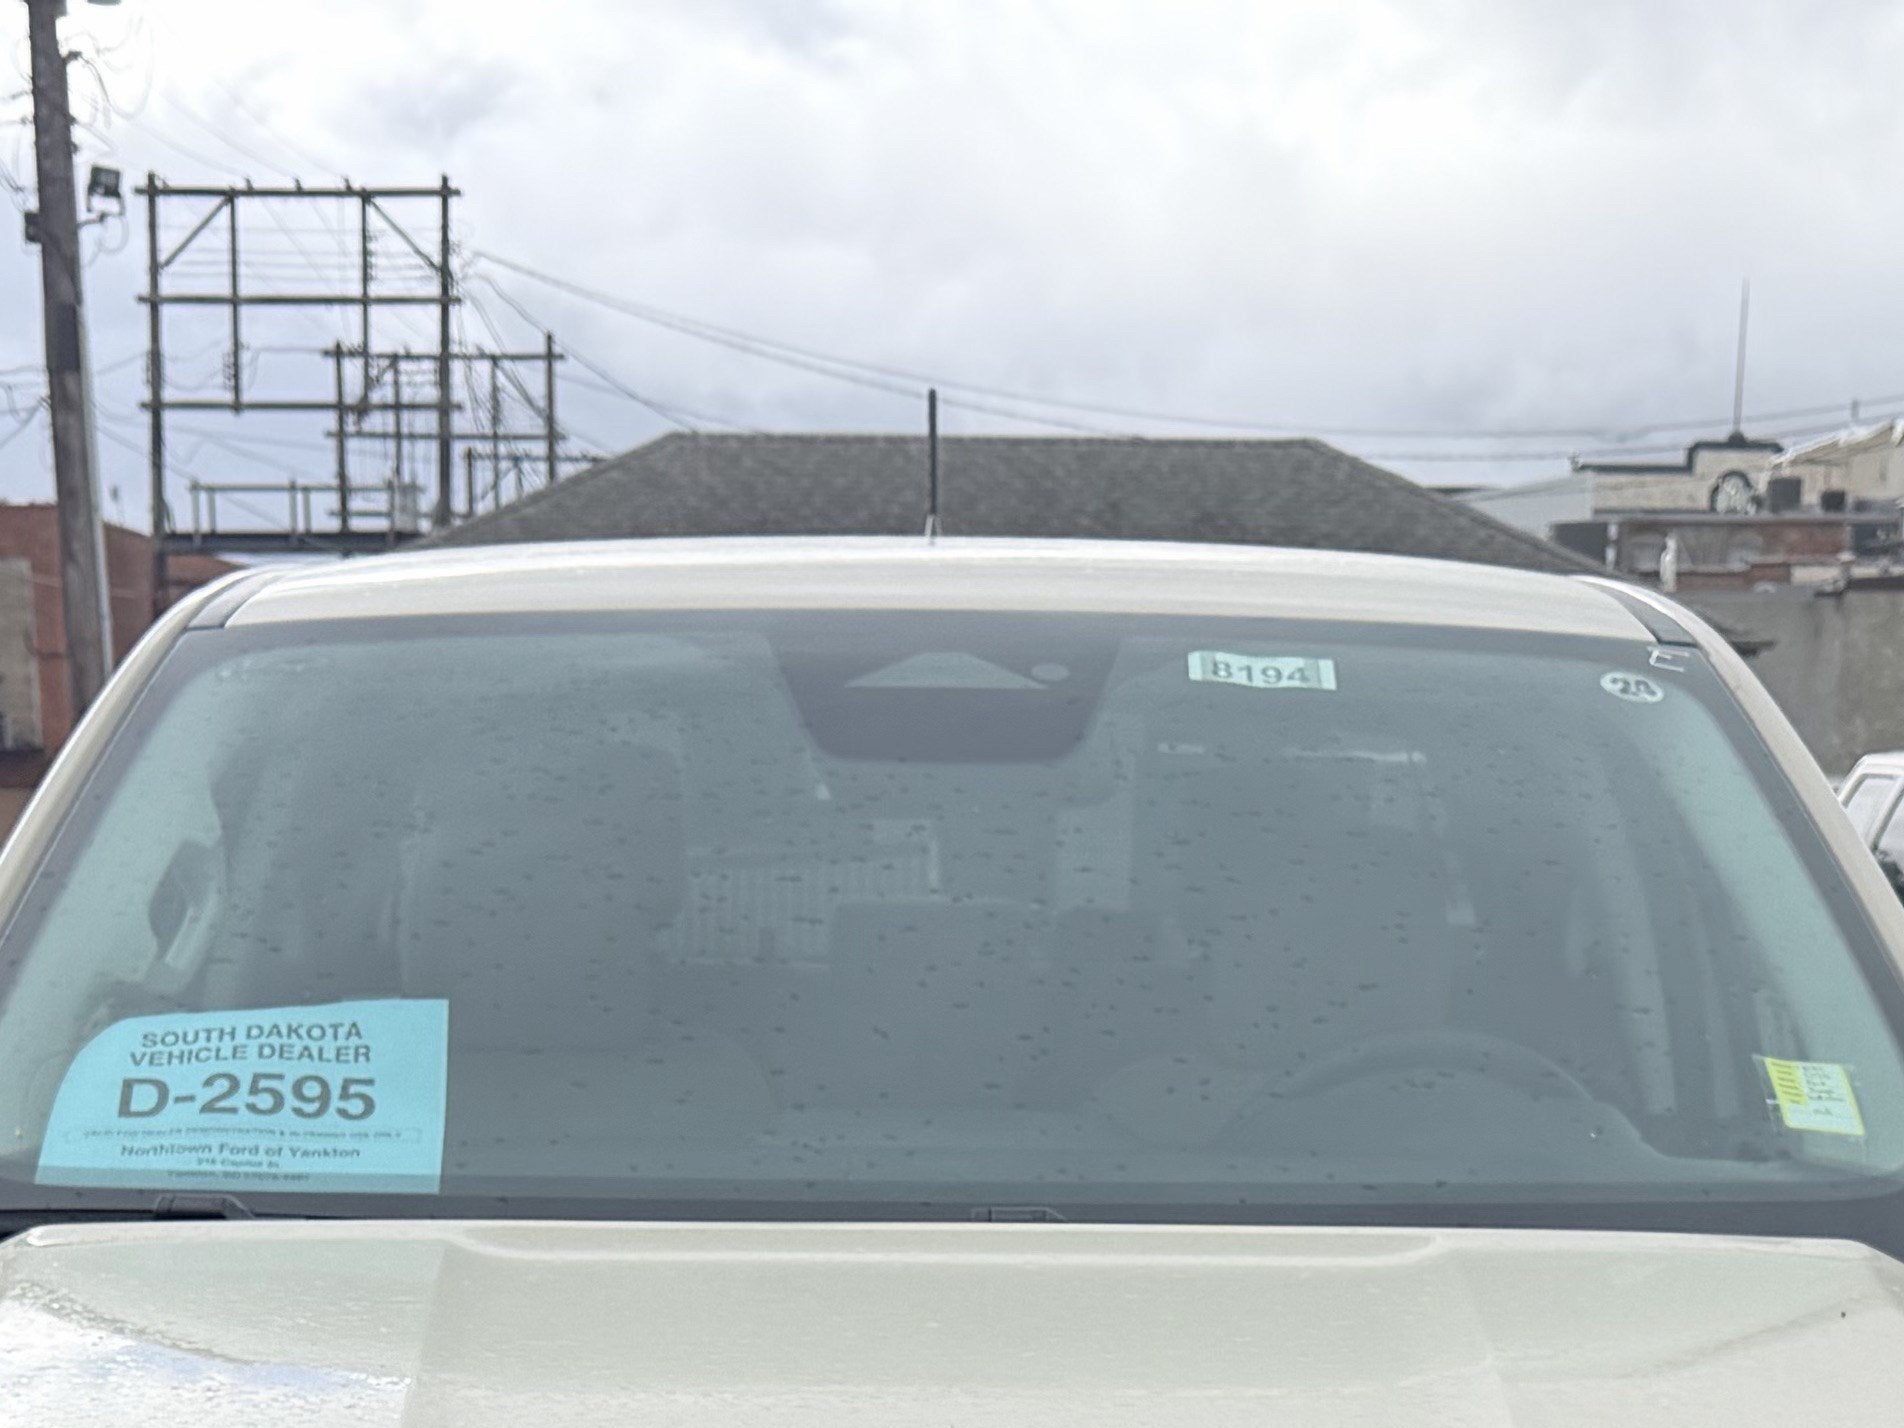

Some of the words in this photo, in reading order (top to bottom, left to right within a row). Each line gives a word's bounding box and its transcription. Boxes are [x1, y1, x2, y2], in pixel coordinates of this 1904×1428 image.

[140, 1025, 237, 1049] SOUTH
[244, 1021, 363, 1042] DAKOTA
[129, 1043, 248, 1068] VEHICLE
[257, 1042, 372, 1065] DEALER
[116, 1072, 377, 1122] D-2595
[121, 1143, 213, 1158] Northtown
[218, 1142, 260, 1157] Ford
[264, 1144, 283, 1158] of
[289, 1145, 361, 1159] Yankton
